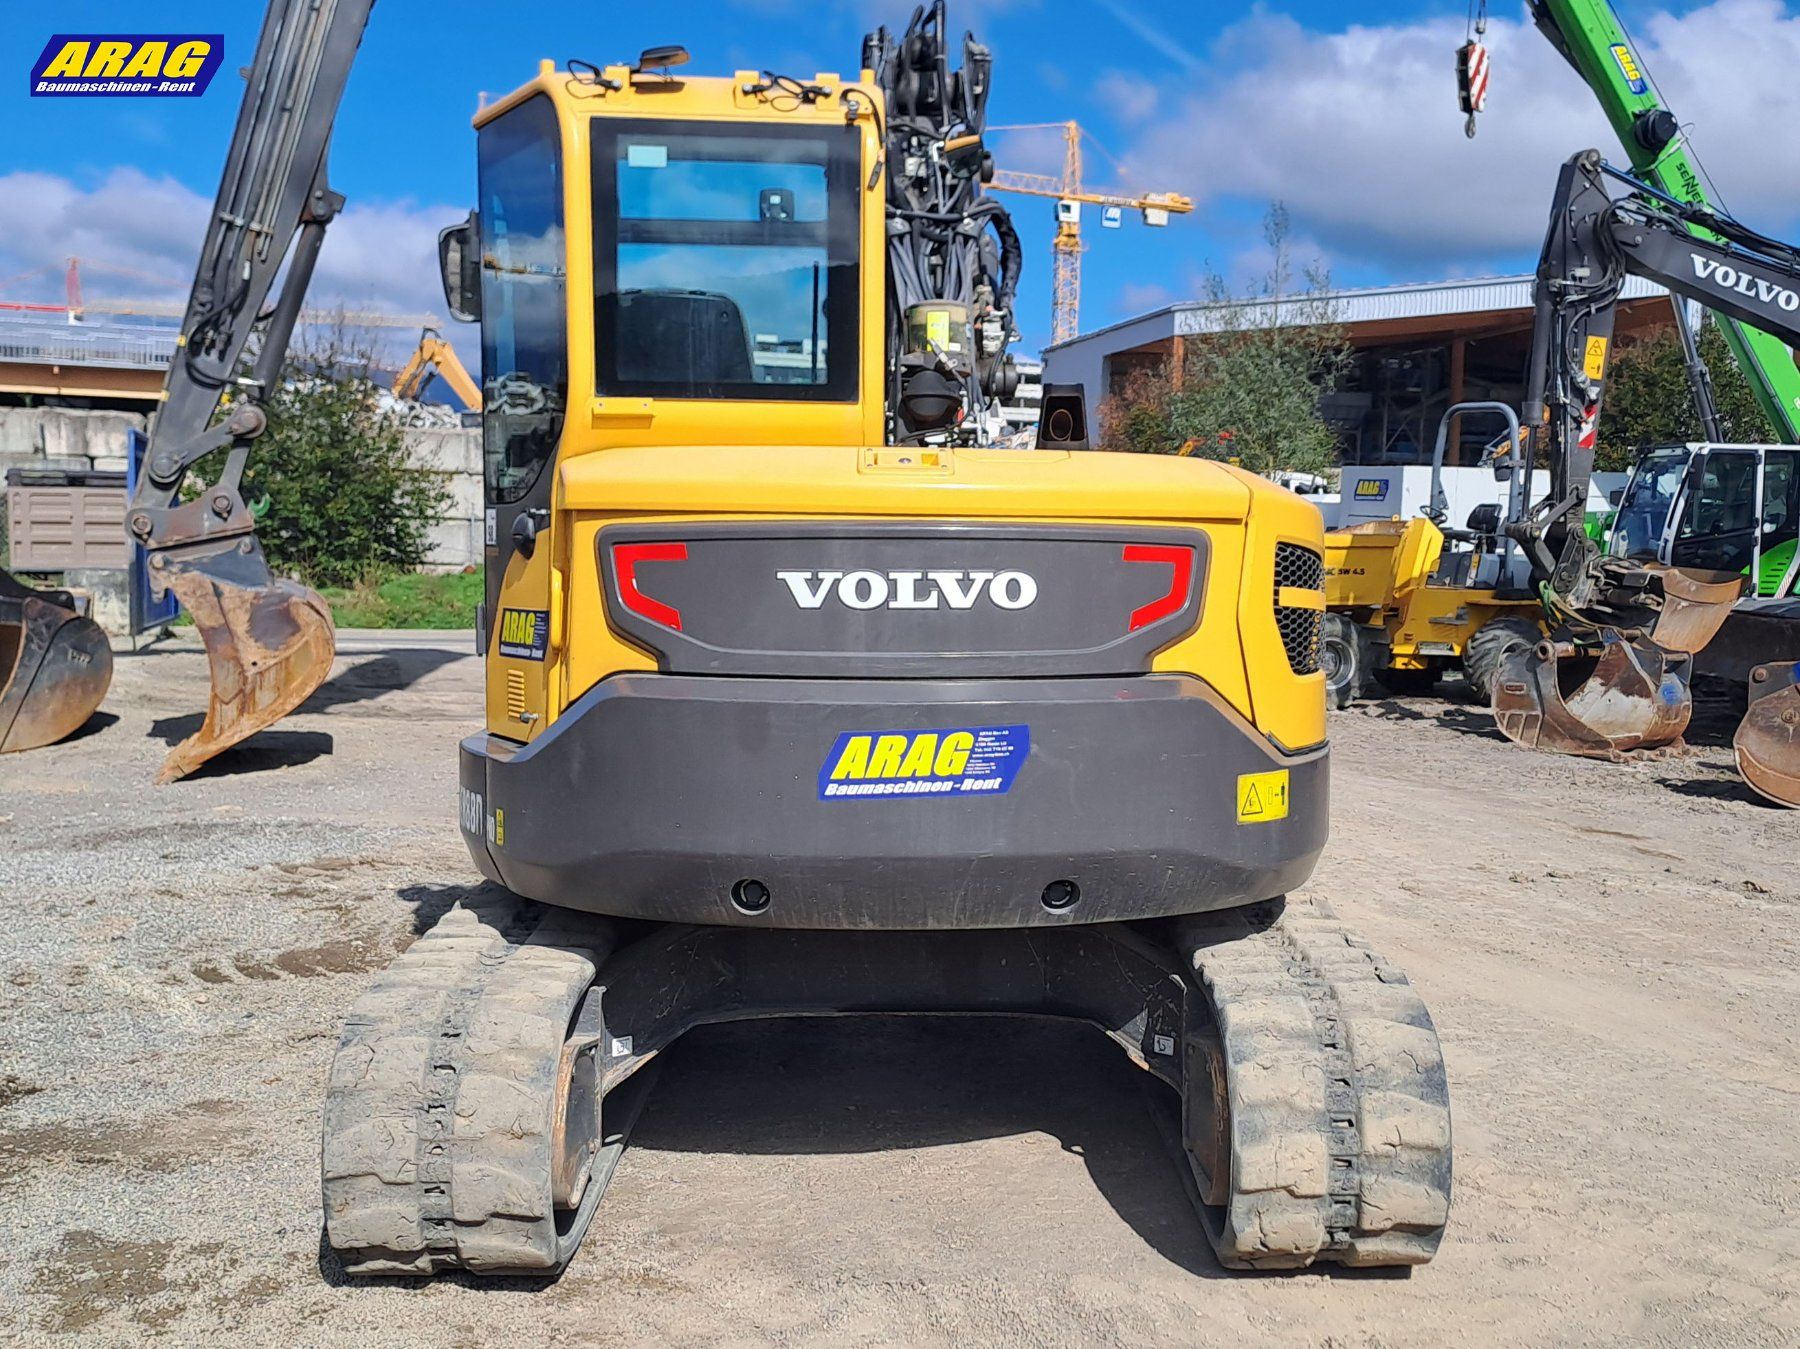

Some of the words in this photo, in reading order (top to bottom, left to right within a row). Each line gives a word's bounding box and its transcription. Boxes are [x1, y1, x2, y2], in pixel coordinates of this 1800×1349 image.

[1614, 46, 1641, 81] ARAG
[1690, 253, 1799, 311] VOLVO
[1356, 480, 1380, 495] ARAG
[776, 571, 1038, 610] VOLVO
[502, 611, 535, 645] ARAG
[830, 731, 974, 780] ARAG
[824, 777, 1003, 796] Baumaschinen-Rent
